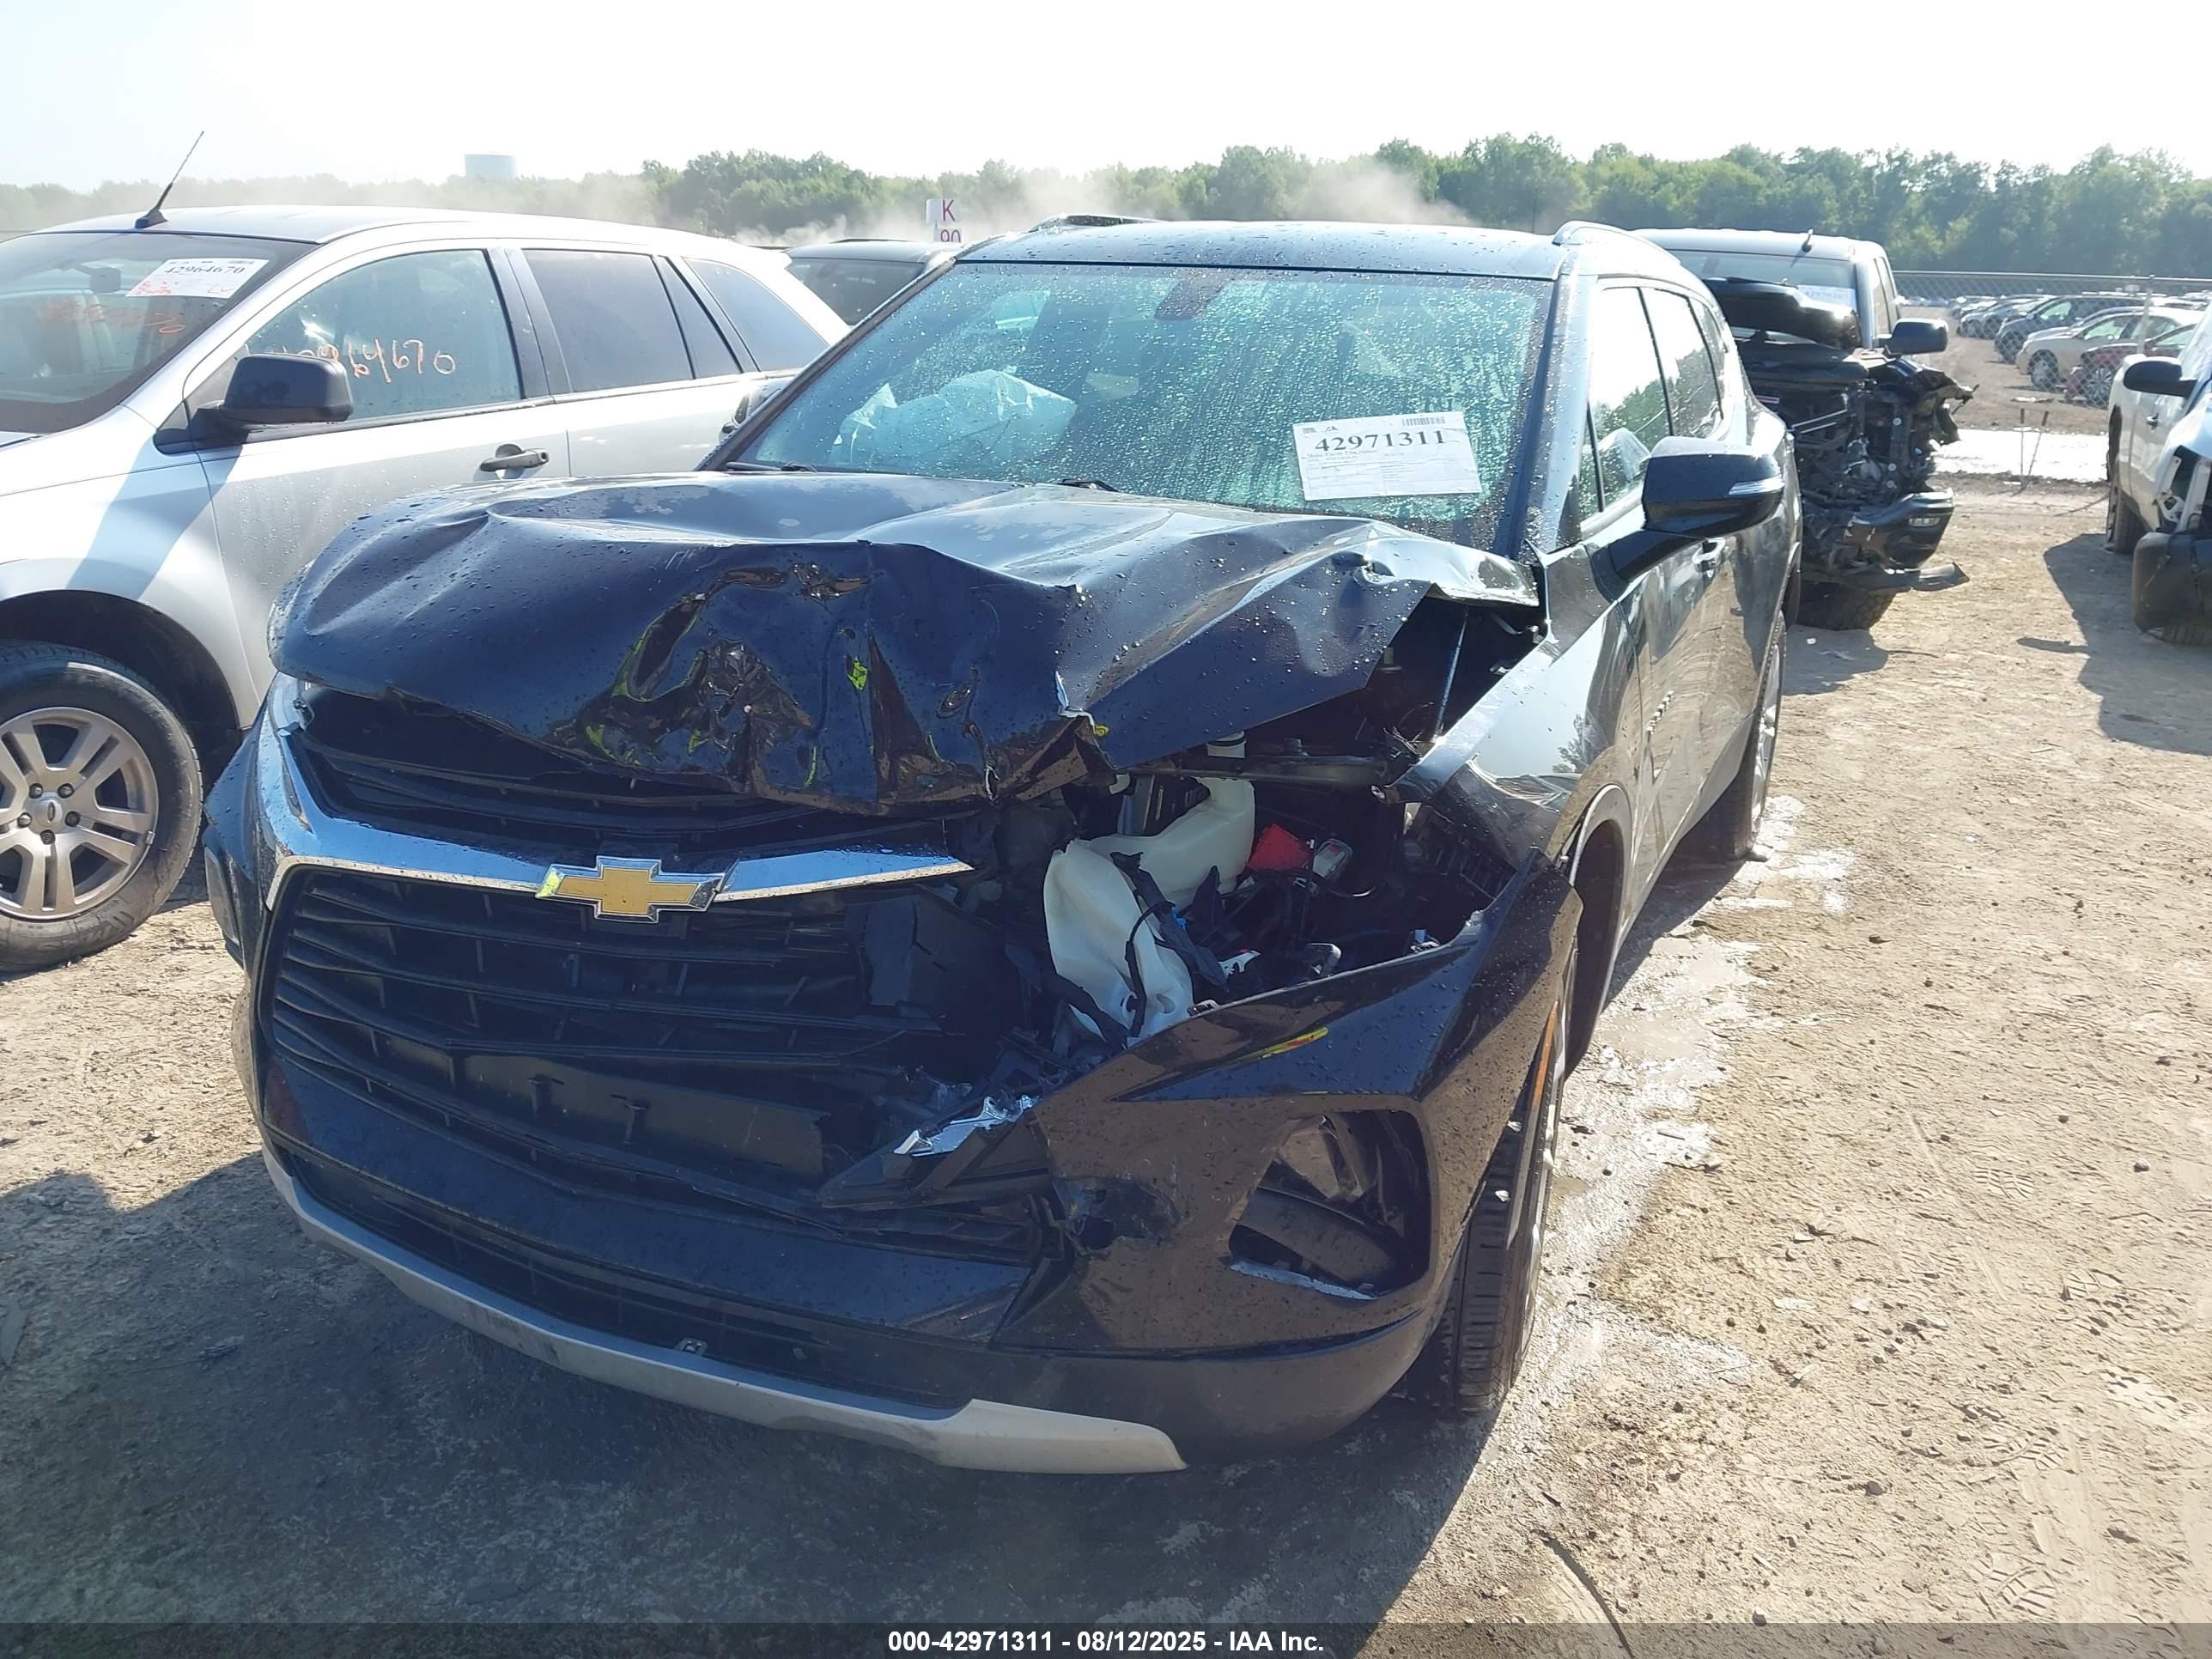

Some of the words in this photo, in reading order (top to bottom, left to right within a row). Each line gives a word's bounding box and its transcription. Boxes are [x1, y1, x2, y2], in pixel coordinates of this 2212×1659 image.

[942, 199, 955, 222] K
[164, 265, 246, 274] 42964670
[1315, 430, 1446, 452] 42971311
